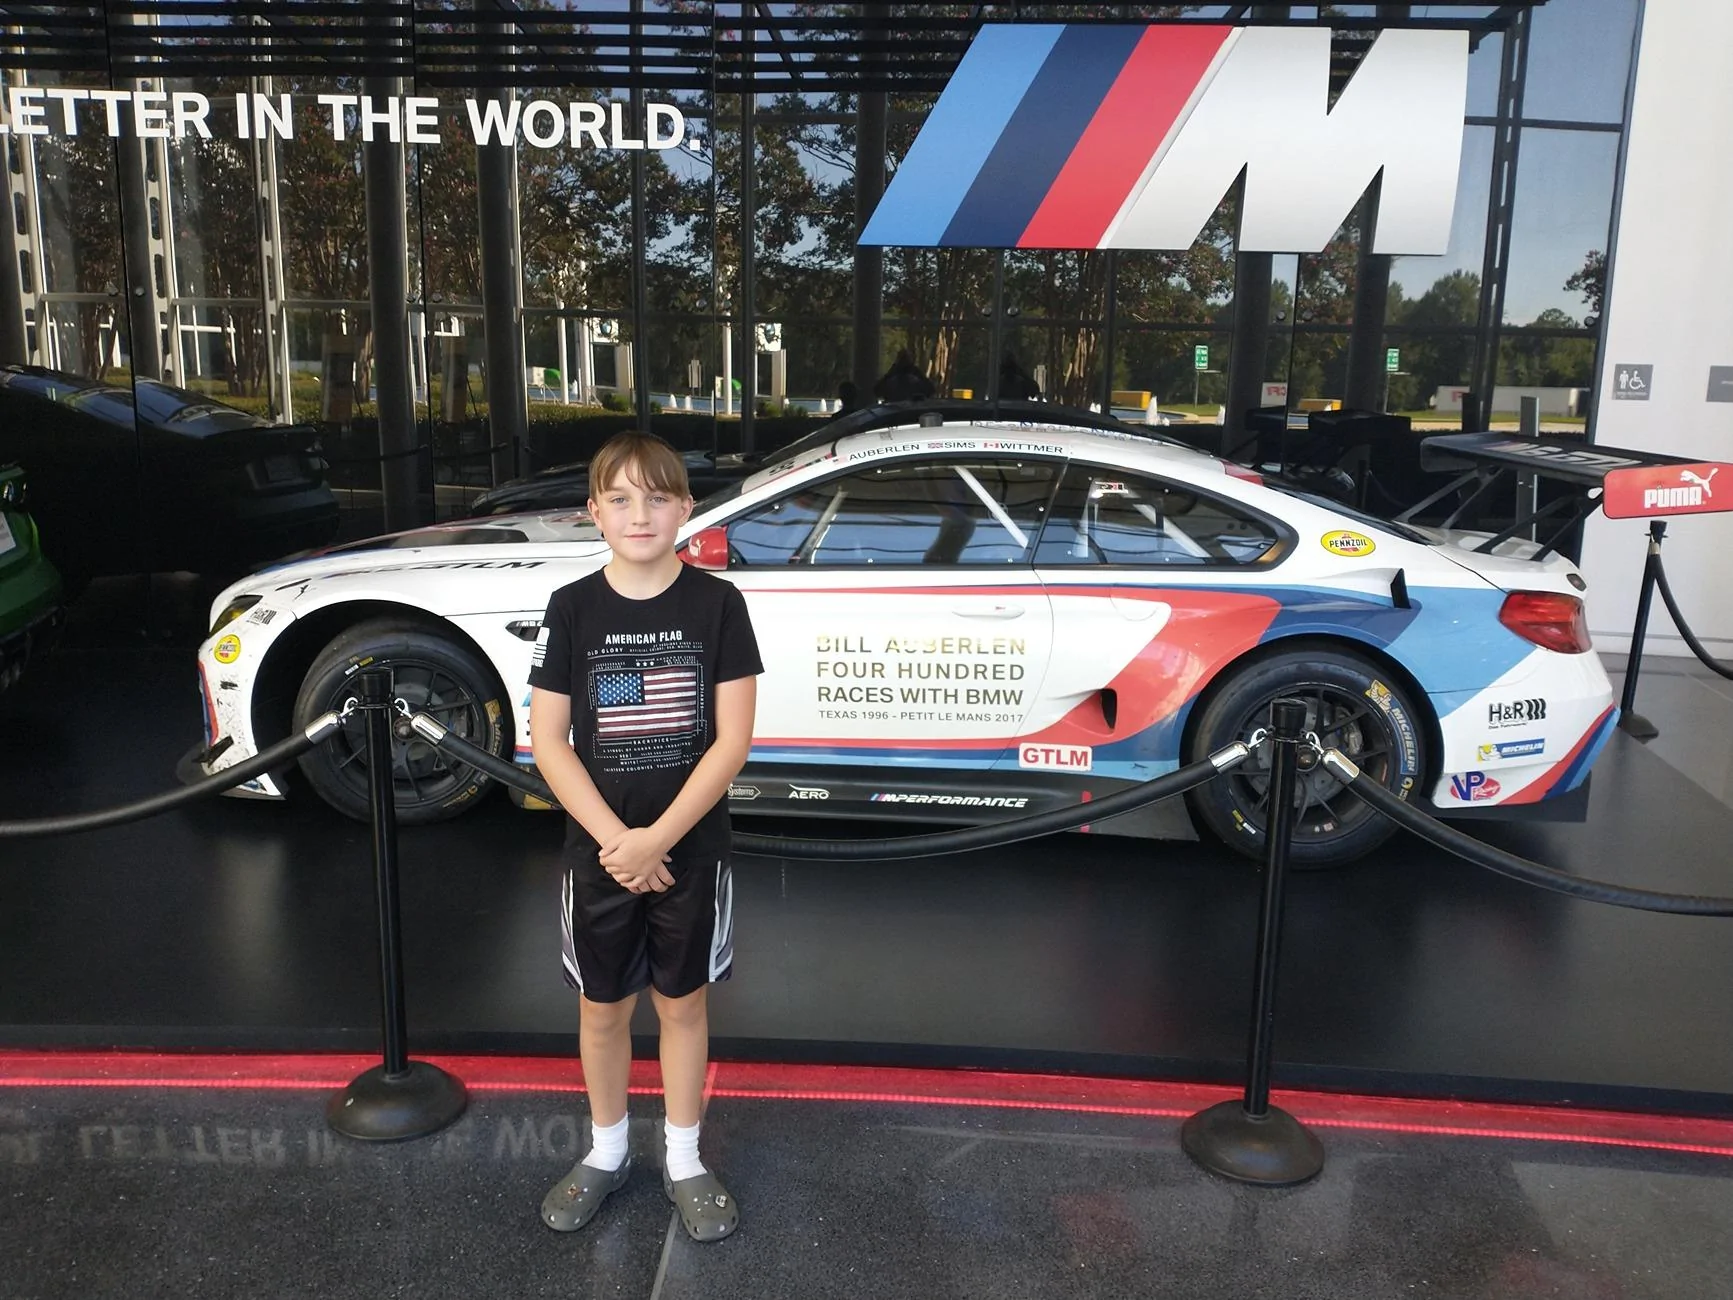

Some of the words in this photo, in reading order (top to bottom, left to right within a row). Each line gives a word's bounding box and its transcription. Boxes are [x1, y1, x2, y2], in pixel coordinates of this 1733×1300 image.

[237, 92, 294, 140] IN
[317, 95, 440, 144] THE
[465, 99, 701, 150] WORLD.
[849, 443, 920, 461] AUBERLEN
[944, 441, 976, 449] SIMS
[1000, 442, 1064, 454] WITTMER
[1644, 486, 1702, 509] PUMA
[1329, 538, 1368, 549] PENNZOIL
[605, 632, 656, 645] AMERICAN
[659, 630, 683, 643] FLAG
[816, 636, 872, 653] BILL
[817, 661, 885, 679] FOUR
[898, 662, 1025, 681] HUNDRED
[817, 686, 894, 704] RACES
[900, 687, 959, 705] WITH
[966, 688, 1024, 706] BMW
[819, 710, 858, 719] TEXAS
[862, 710, 889, 720] 1996
[900, 711, 936, 721] PETIT
[938, 712, 952, 721] LE
[956, 712, 992, 722] MANS
[995, 713, 1024, 722] 2017
[1488, 701, 1525, 722] H&R
[633, 737, 670, 745] SACRIFICE
[1391, 708, 1416, 772] MICHELIN
[1022, 747, 1089, 767] GTLM
[788, 790, 829, 800] AERO
[1451, 771, 1486, 801] VP
